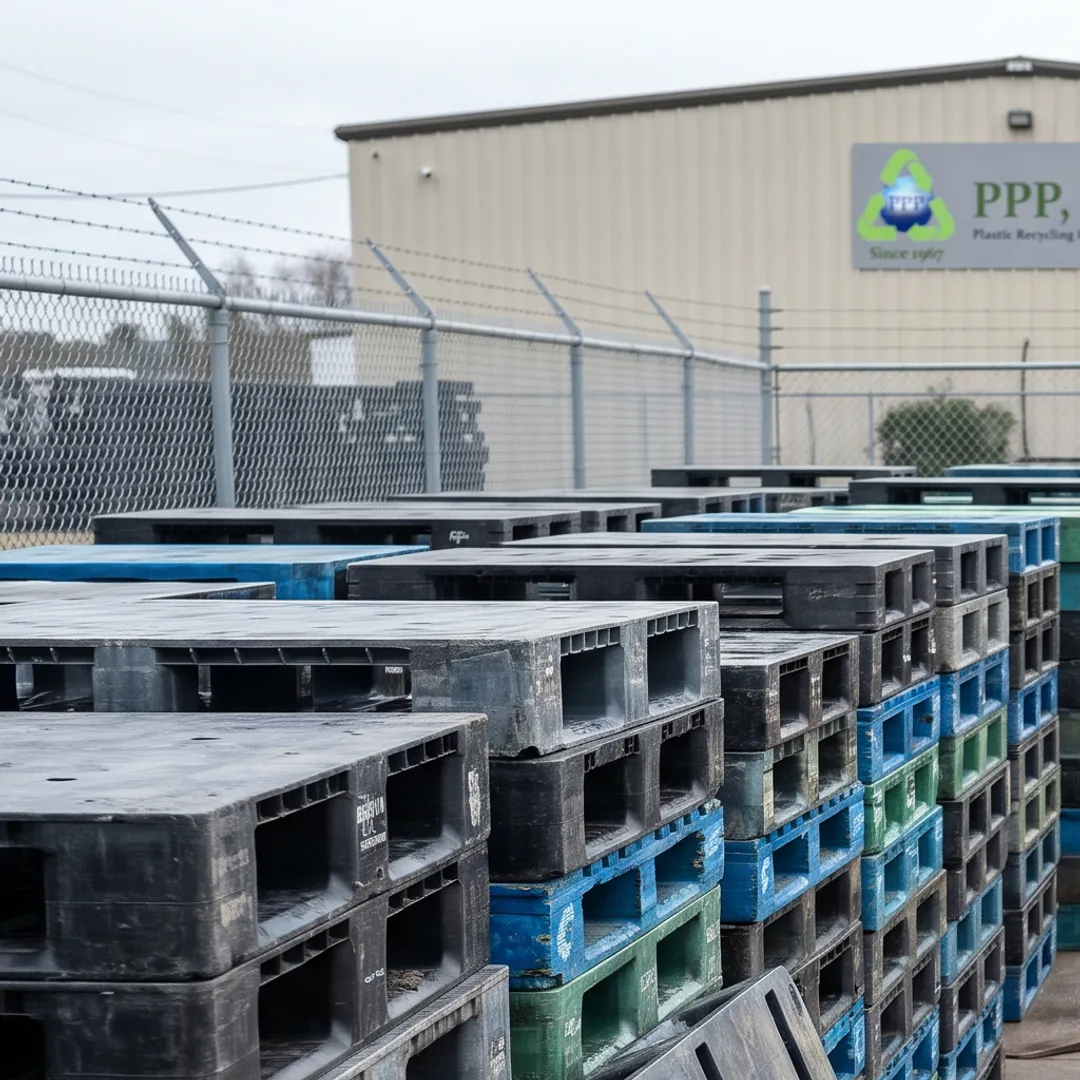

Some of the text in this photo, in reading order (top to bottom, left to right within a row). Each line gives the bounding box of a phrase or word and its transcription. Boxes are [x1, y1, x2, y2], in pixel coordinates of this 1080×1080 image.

[889, 196, 926, 211] PPP
[972, 181, 1069, 225] PPP,
[972, 228, 1012, 240] Plastic
[1016, 228, 1075, 243] Recycling
[869, 246, 909, 260] Since
